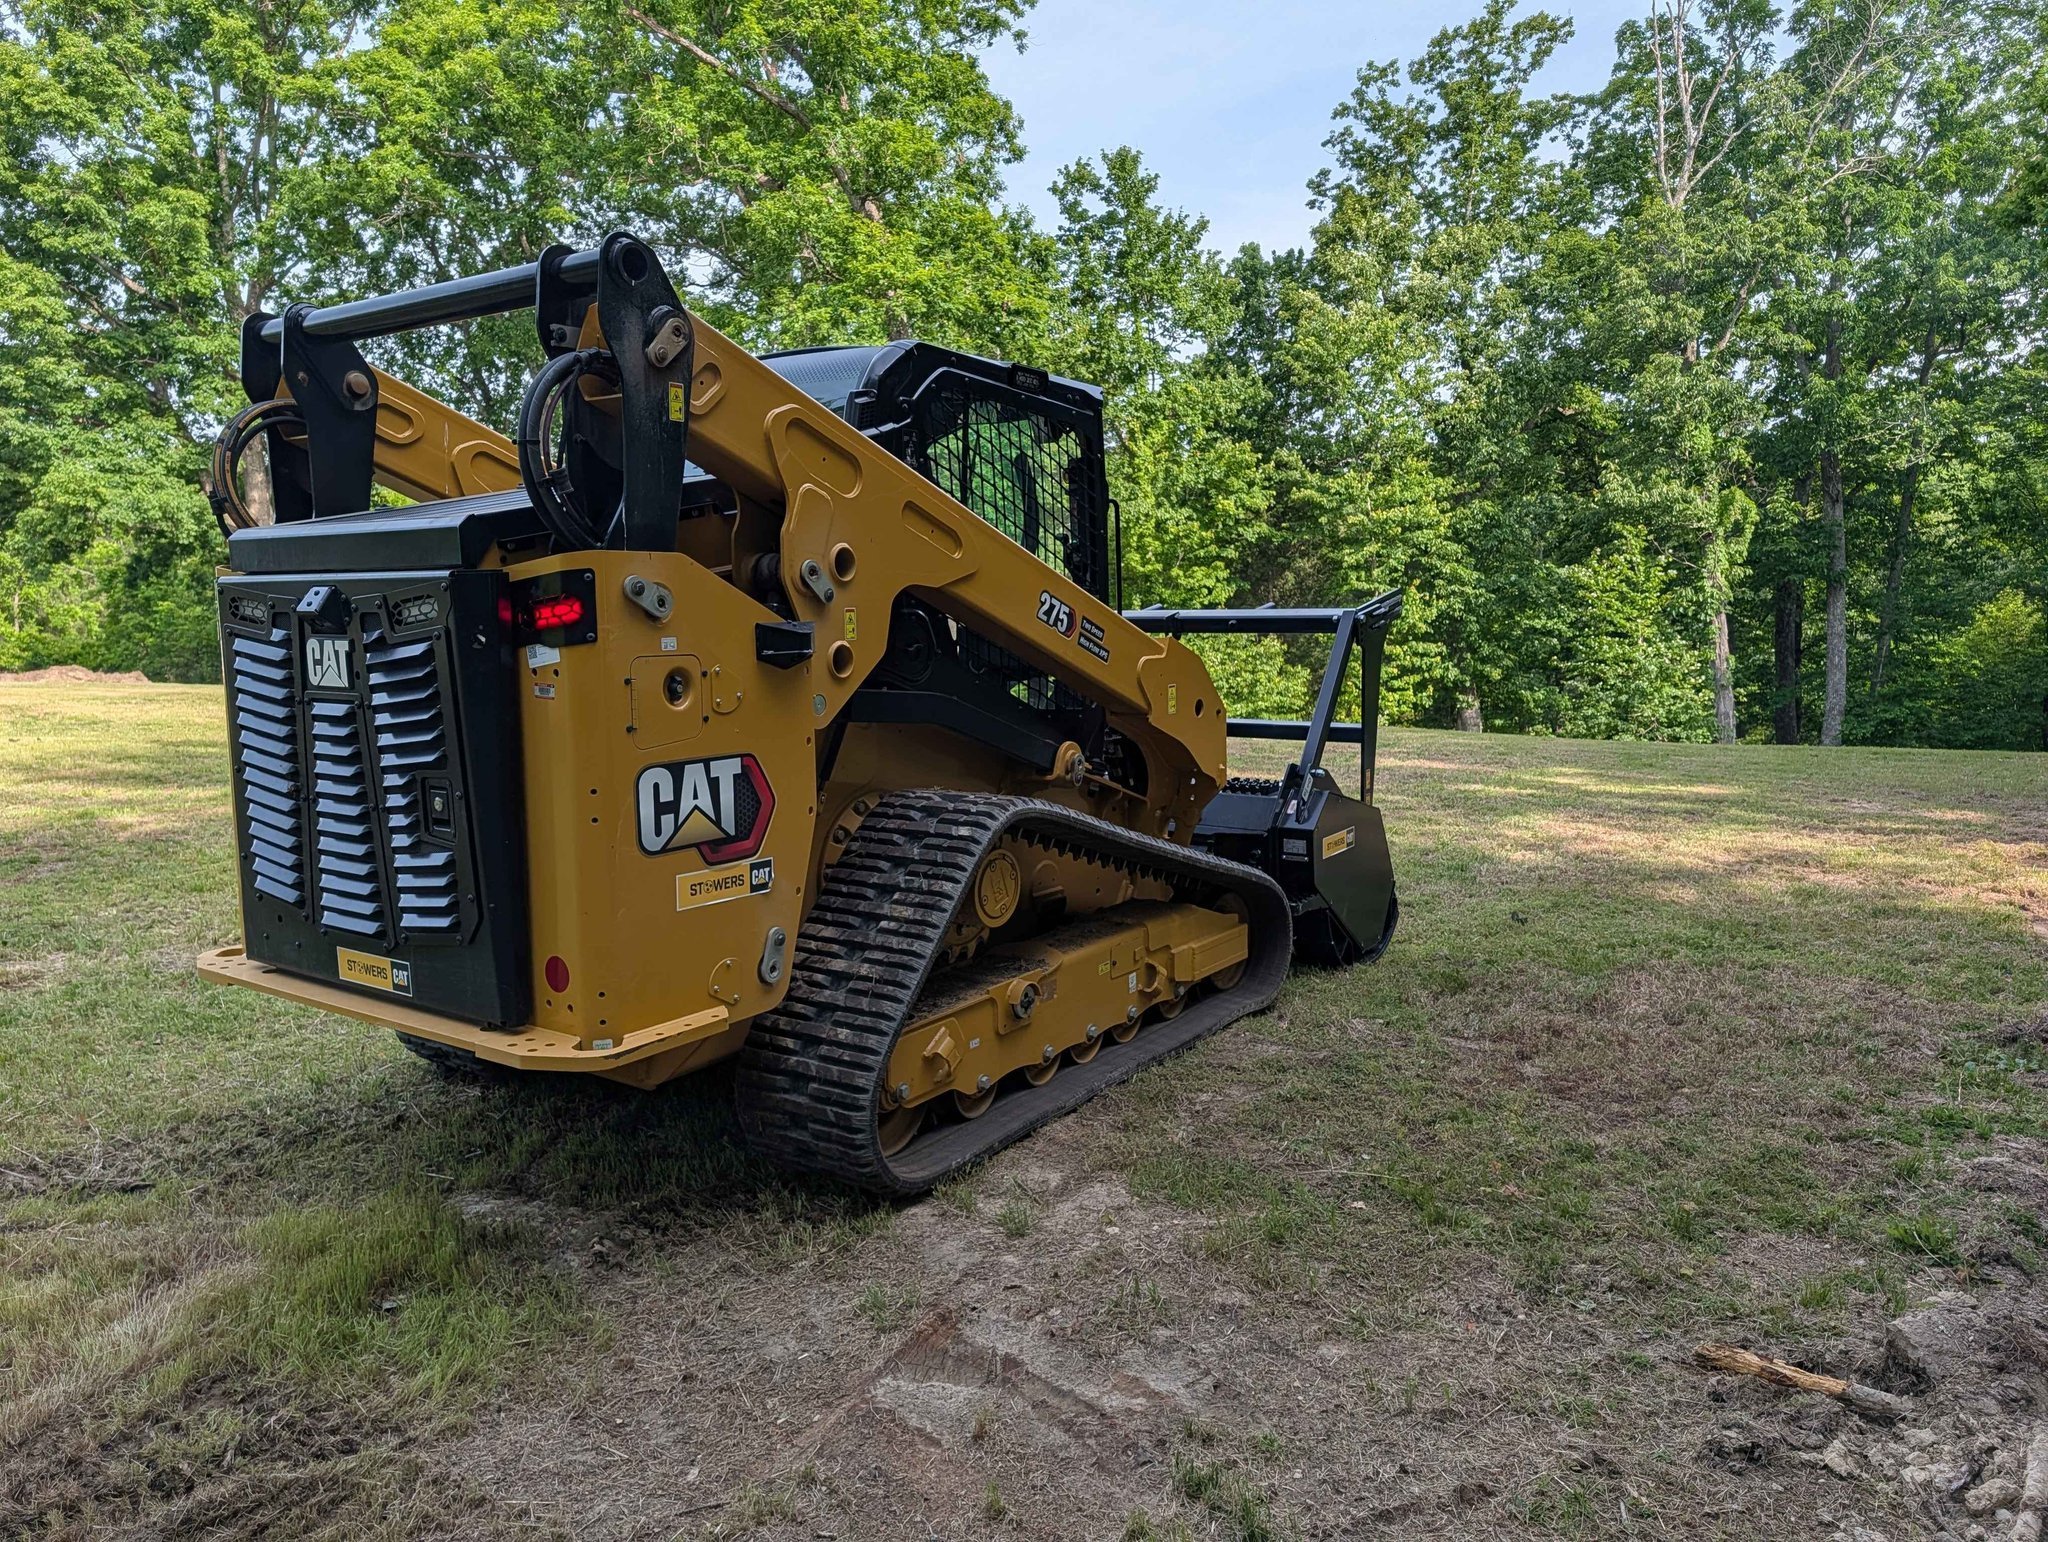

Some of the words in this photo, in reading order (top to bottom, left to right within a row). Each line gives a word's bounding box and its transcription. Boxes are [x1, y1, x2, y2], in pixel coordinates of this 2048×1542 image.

[1037, 592, 1070, 633] 275
[306, 638, 349, 688] CAT
[638, 757, 742, 852] CAT
[752, 867, 771, 885] CAT
[393, 968, 408, 986] CAT
